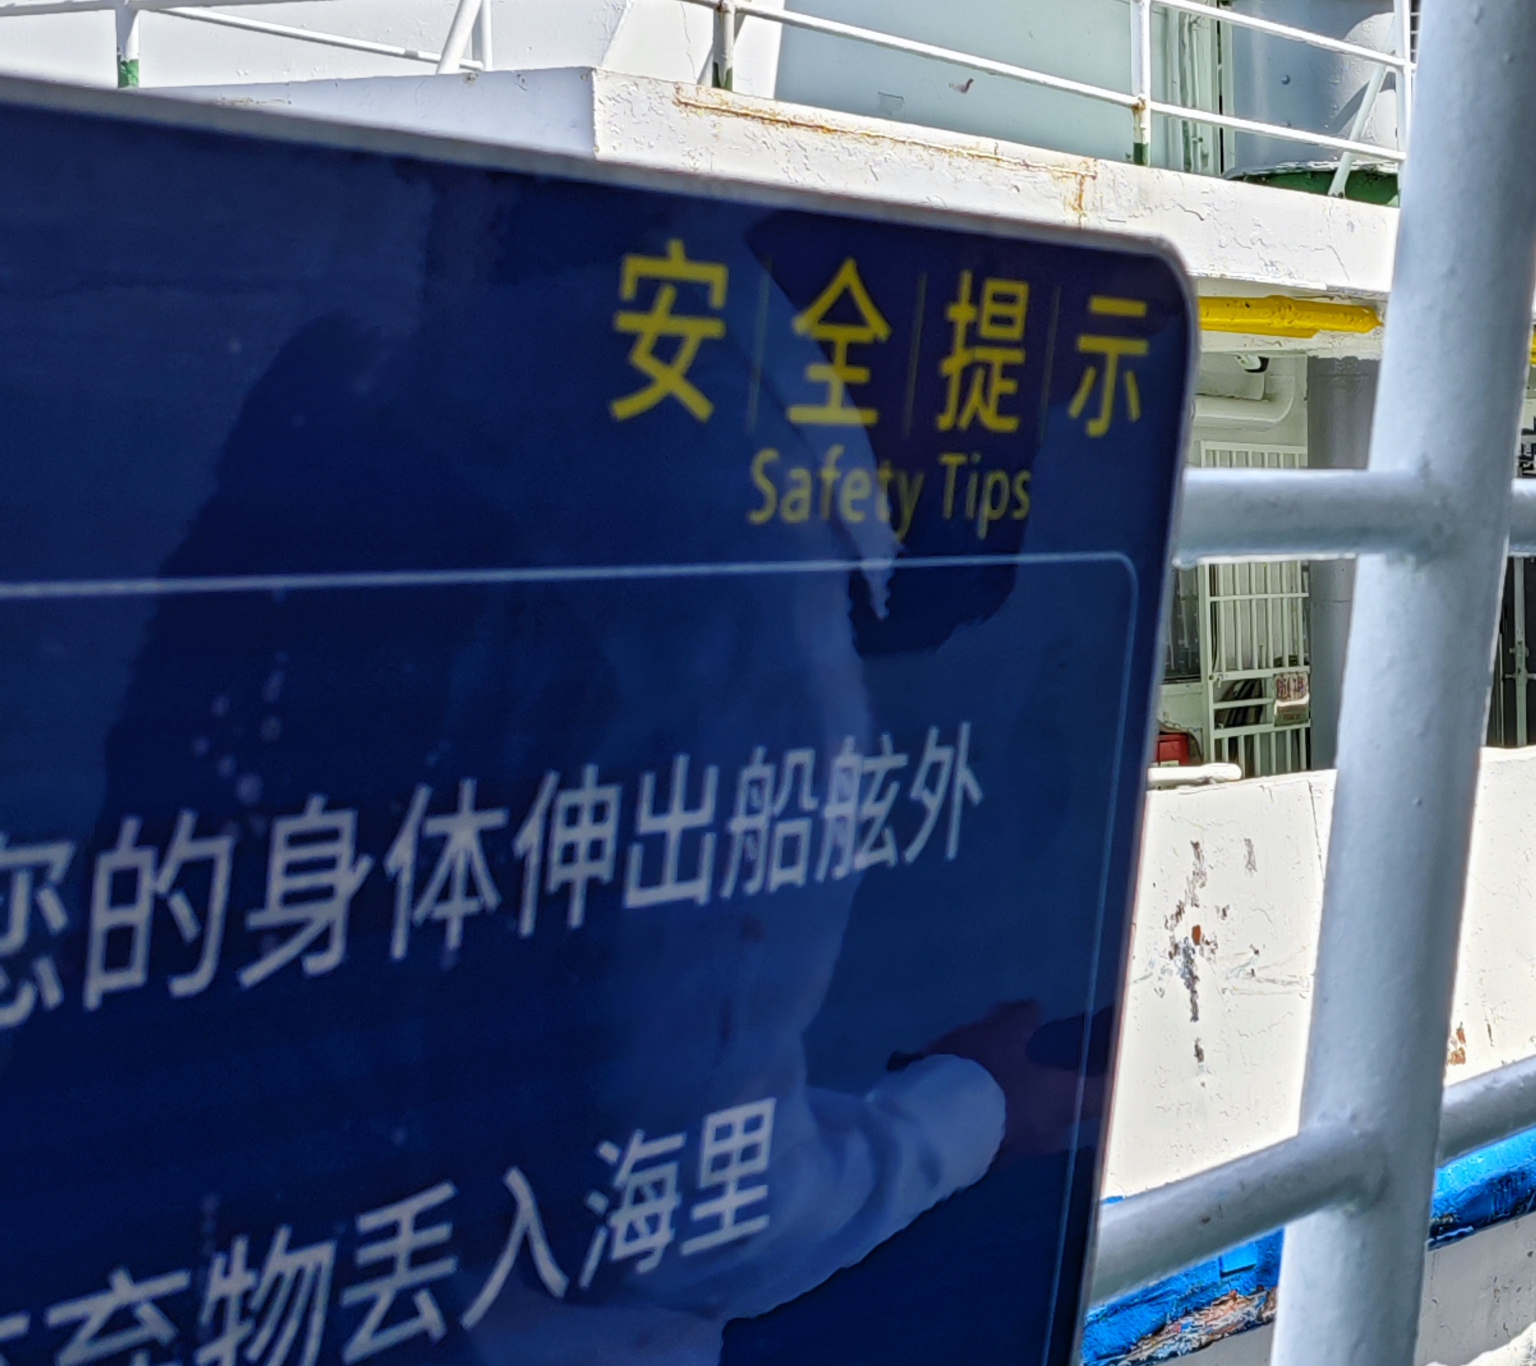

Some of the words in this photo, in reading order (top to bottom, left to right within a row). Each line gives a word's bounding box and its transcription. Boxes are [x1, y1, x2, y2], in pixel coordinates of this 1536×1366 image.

[610, 238, 1149, 436] 安全提示
[746, 445, 924, 543] Safety
[938, 451, 1032, 540] Tips
